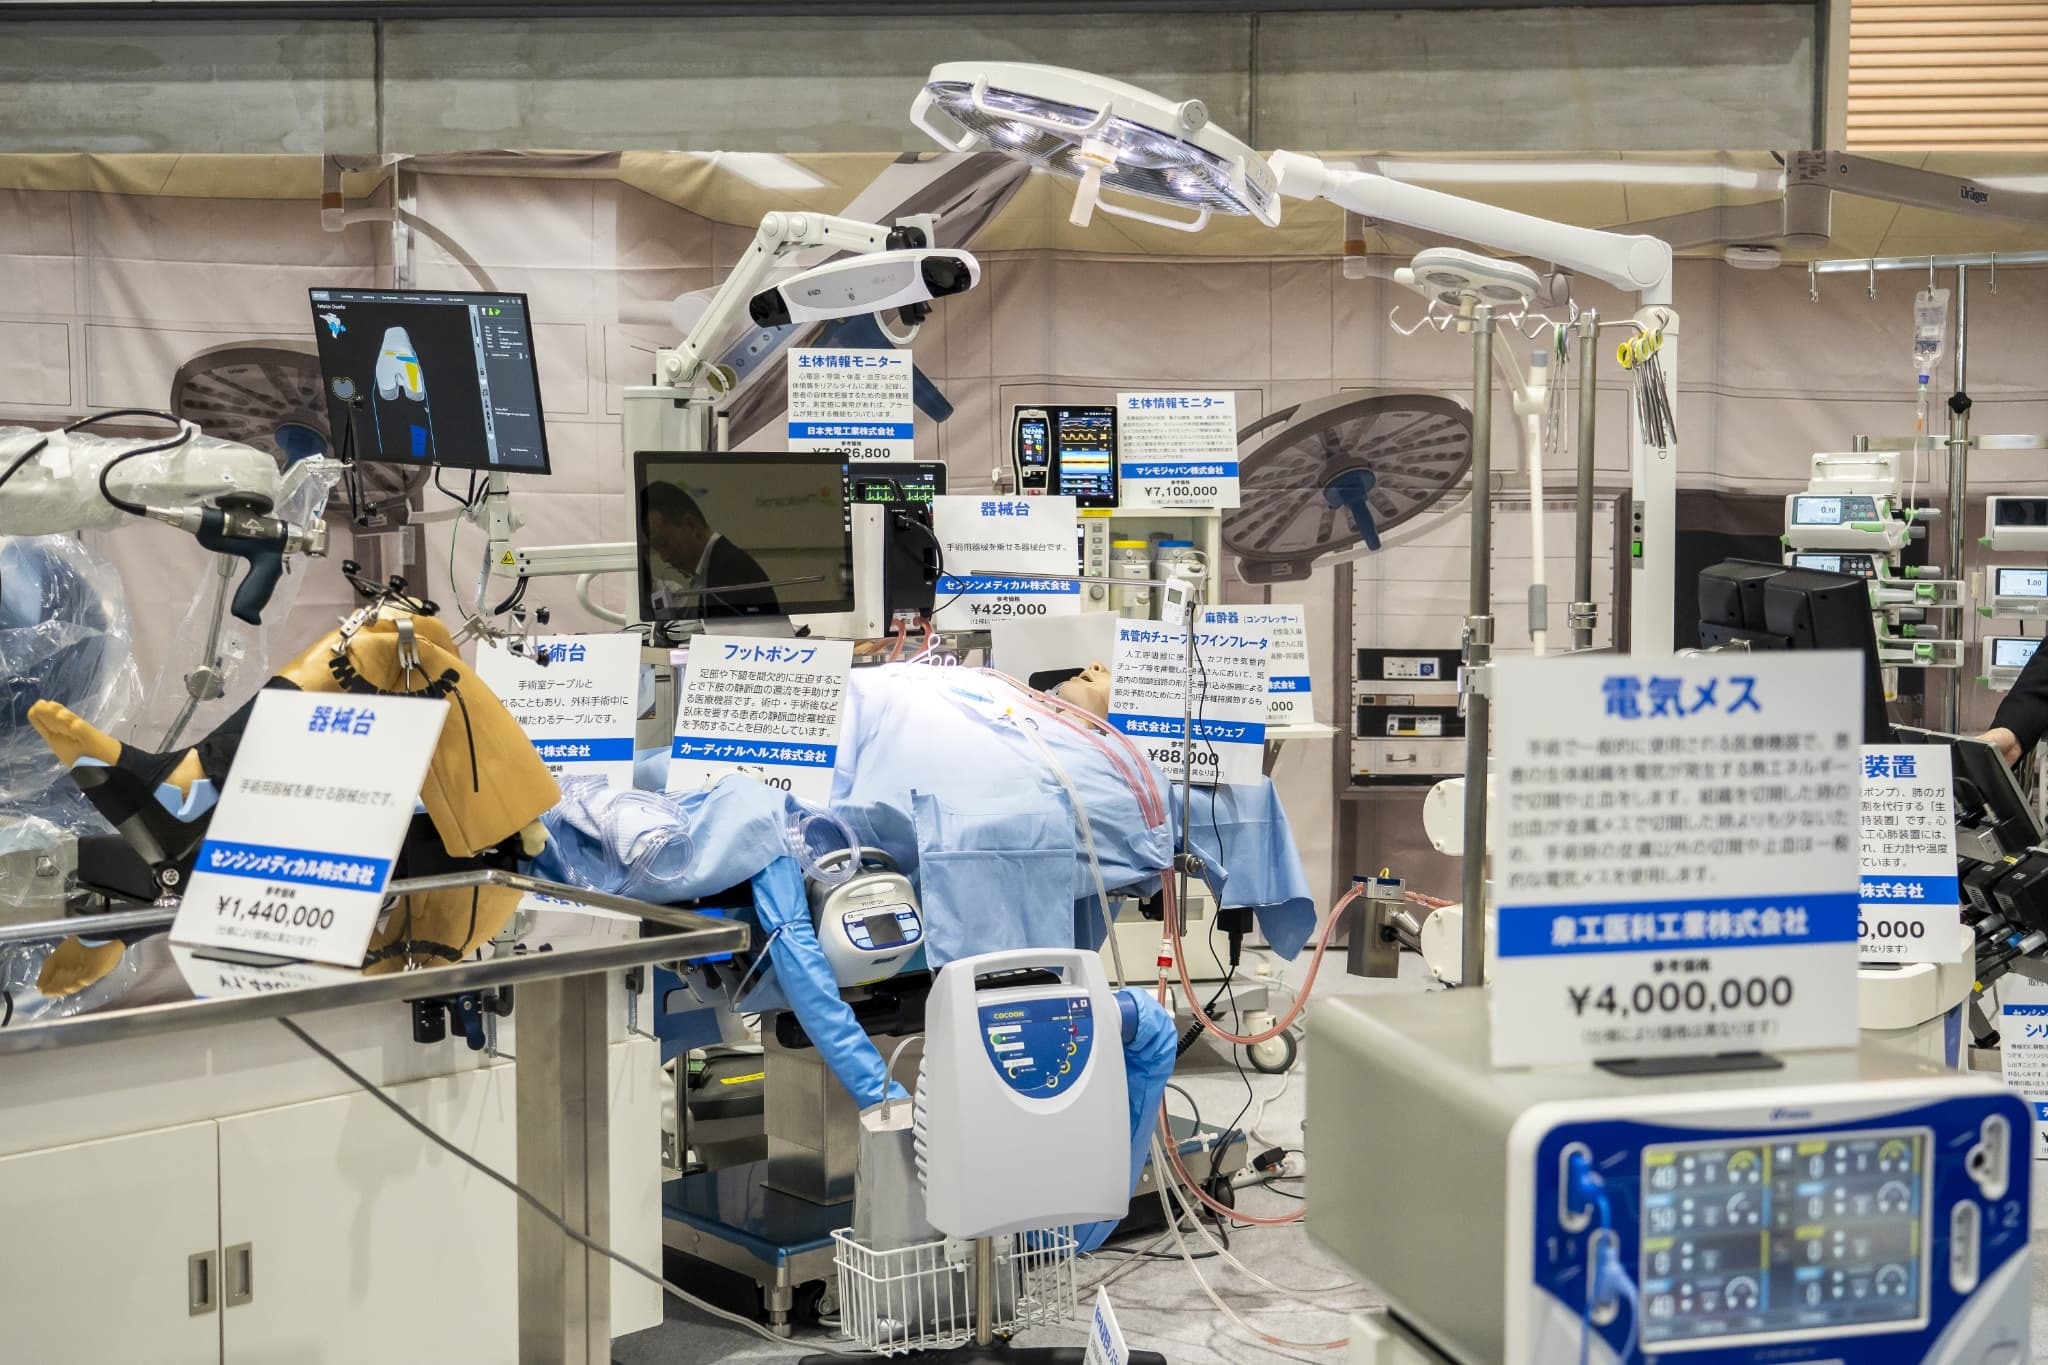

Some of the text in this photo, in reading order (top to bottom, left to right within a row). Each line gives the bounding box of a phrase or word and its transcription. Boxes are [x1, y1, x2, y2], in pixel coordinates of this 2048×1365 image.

[1960, 185, 1988, 203] Dräger
[798, 356, 902, 368] 生体情報モニター
[1128, 396, 1225, 409] 生体情報モニター
[807, 426, 895, 436] 日本光電工業株式会社
[1136, 466, 1224, 475] マシモジャパン株式会社
[1144, 486, 1218, 497] ¥7,100,000
[980, 502, 1030, 517] 器械台
[946, 542, 1067, 552] 手術用器械を乗せる器械台です。
[945, 580, 1071, 591] センシンメディカル株式会社
[970, 604, 1048, 616] ¥429,000
[1205, 612, 1239, 624] 麻酔器
[724, 644, 818, 664] フットポンプ
[518, 678, 593, 690] 手術室テーブルと
[1601, 674, 1762, 720] 電気メス
[308, 704, 376, 737] 器械台
[680, 742, 828, 763] カーディナルヘルス株式会社
[1859, 754, 1918, 779] 装置
[210, 848, 376, 886] センシンメディカル株式会社
[216, 895, 335, 930] ¥1,440,000
[1567, 975, 1794, 1018] ¥4,000,000
